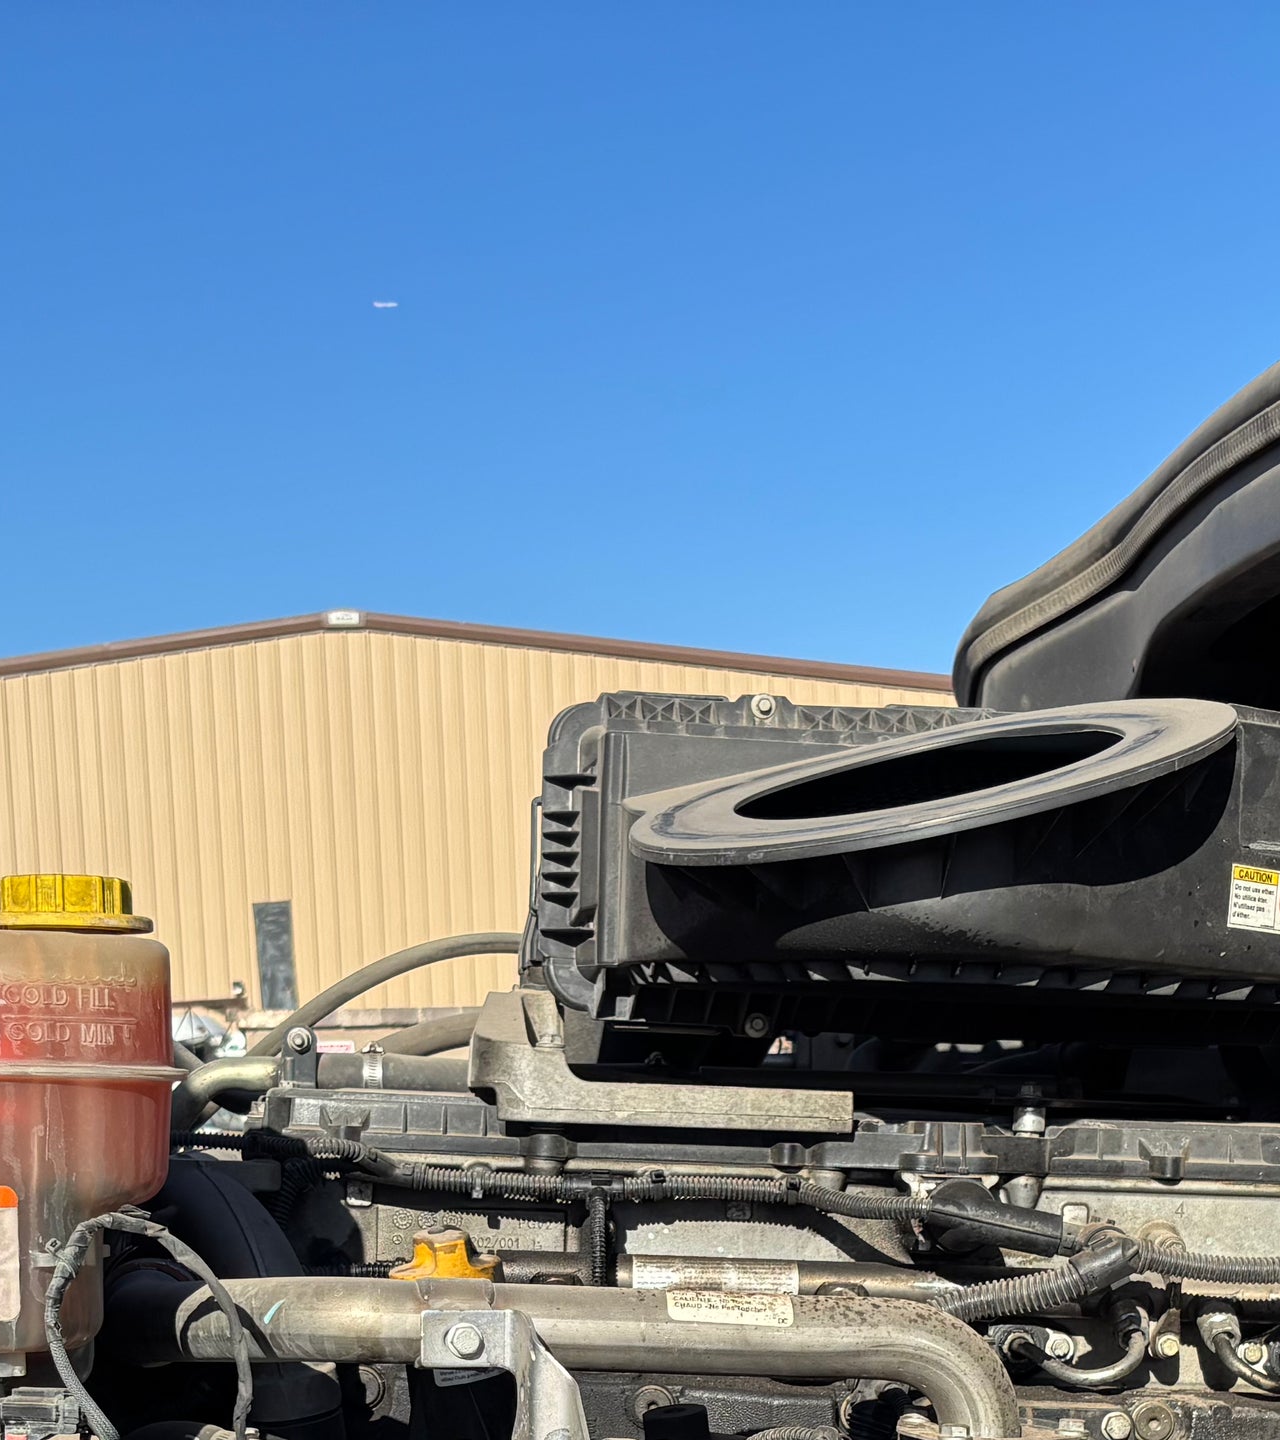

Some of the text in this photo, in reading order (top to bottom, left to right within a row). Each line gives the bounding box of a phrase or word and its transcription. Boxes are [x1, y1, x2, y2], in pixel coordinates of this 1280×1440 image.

[1238, 869, 1273, 883] CAUTION
[3, 983, 116, 1011] COLD FILL
[6, 1021, 116, 1046] COLD MIN
[1175, 1201, 1184, 1218] 4
